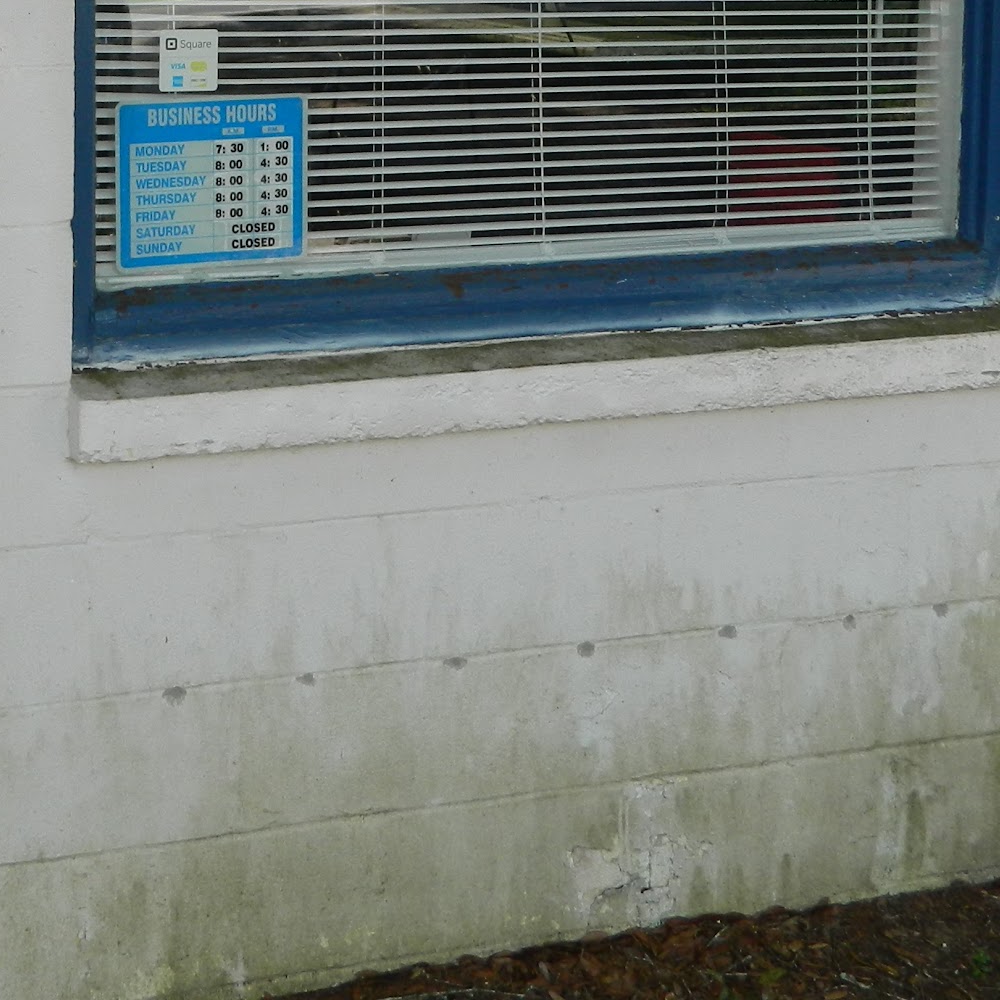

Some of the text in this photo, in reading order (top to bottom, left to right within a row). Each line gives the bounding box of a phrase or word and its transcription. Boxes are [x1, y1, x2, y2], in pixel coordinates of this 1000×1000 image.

[180, 38, 212, 50] Square
[170, 62, 187, 70] VISA
[147, 103, 277, 127] BUSINESS HOURS
[135, 144, 185, 157] MONDAY
[136, 161, 187, 173] TUESDAY
[136, 176, 206, 190] WEDNESDAY
[136, 192, 197, 206] THURSDAY
[135, 210, 176, 222] FRIDAY
[136, 222, 276, 239] SATURDAY CLOSED
[136, 237, 275, 255] SUNDAY CLOSED
